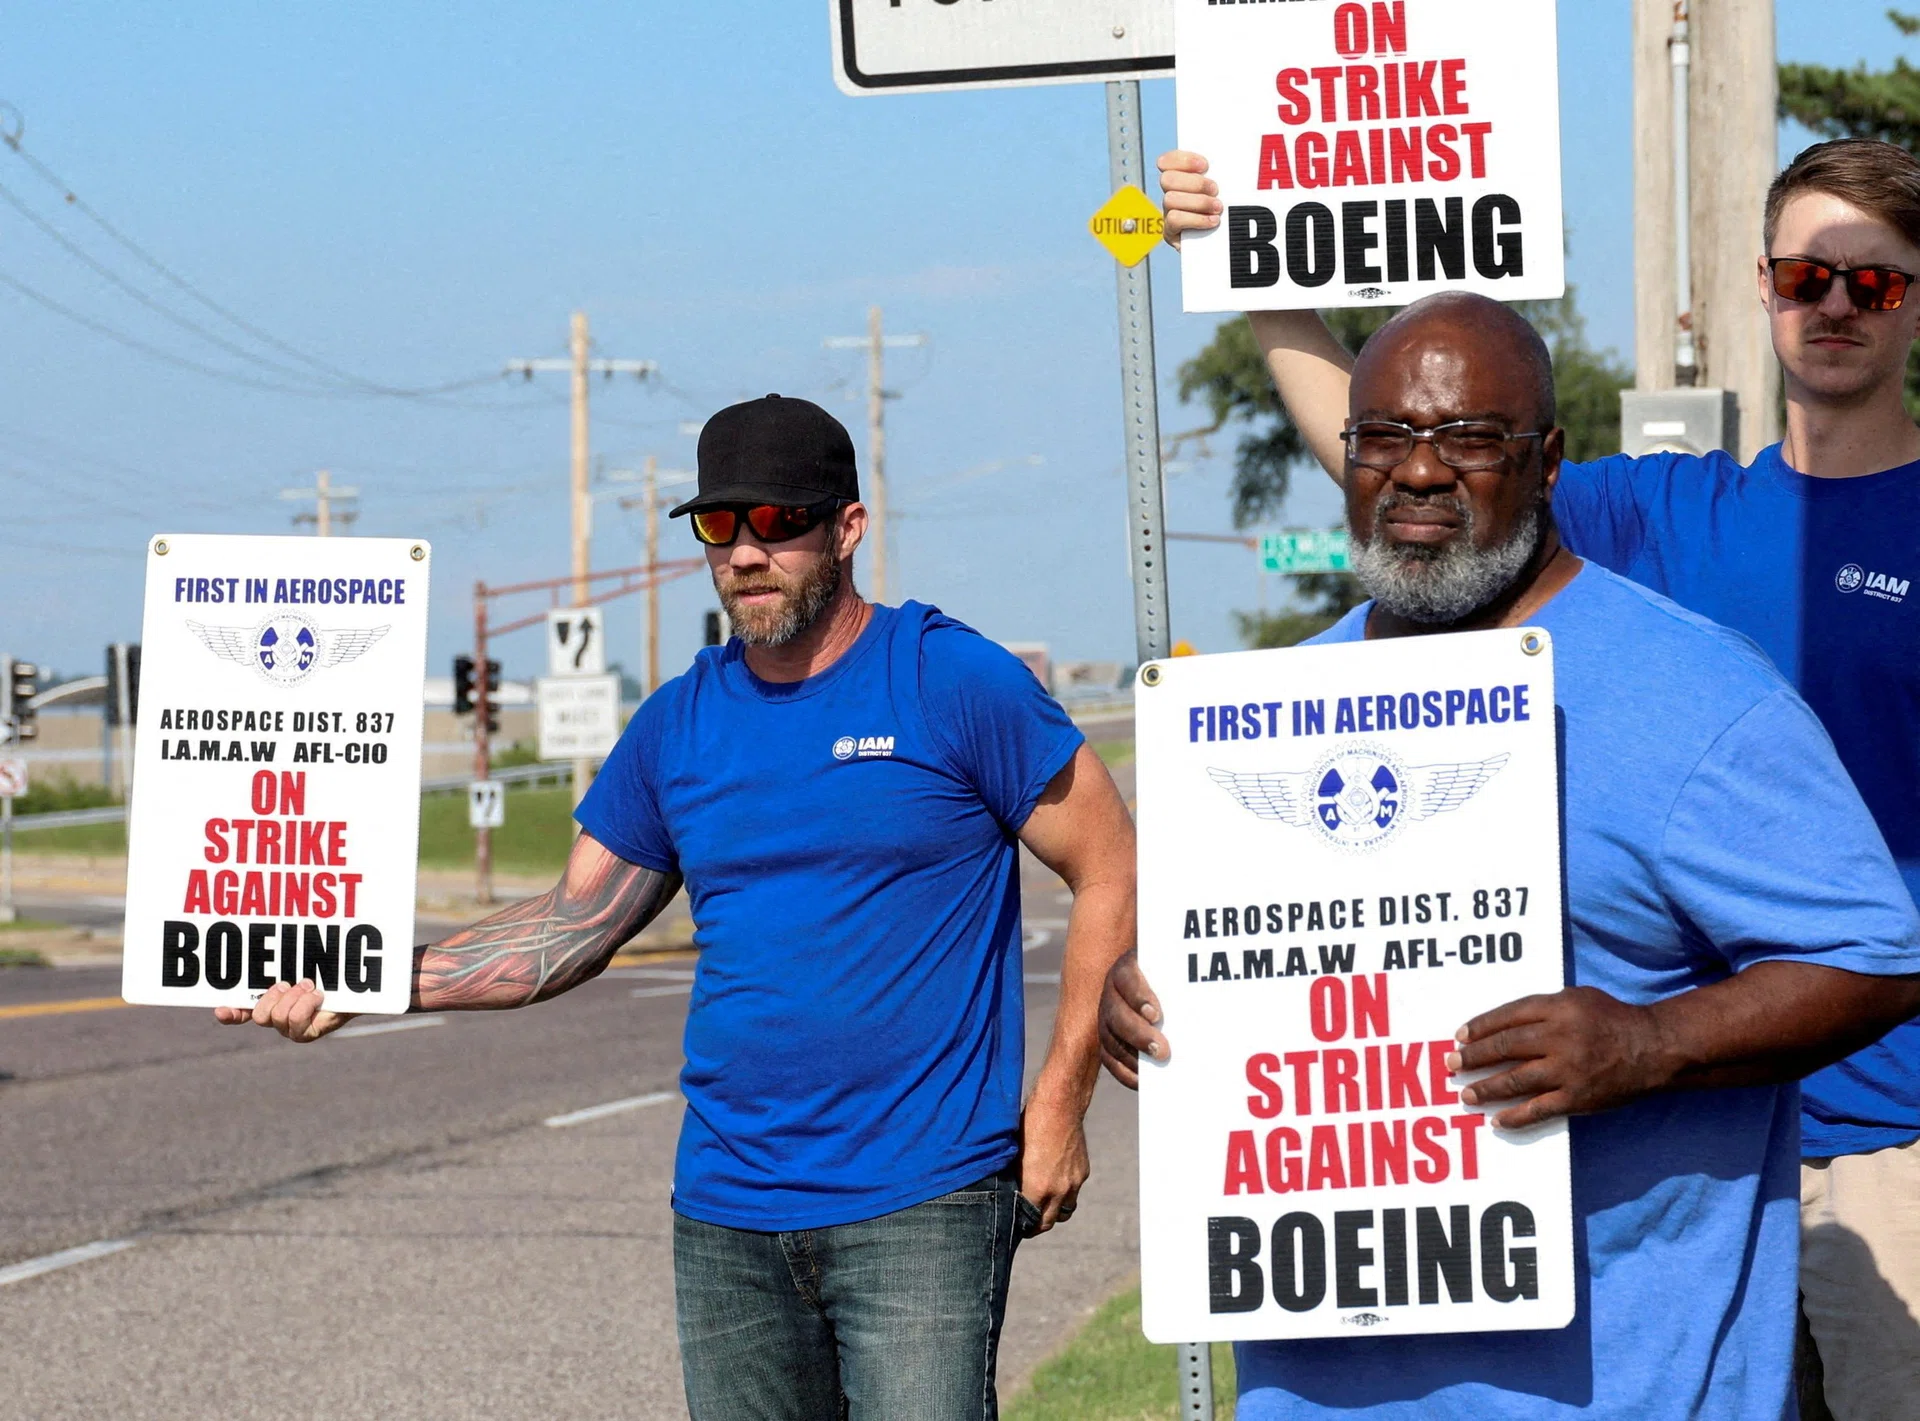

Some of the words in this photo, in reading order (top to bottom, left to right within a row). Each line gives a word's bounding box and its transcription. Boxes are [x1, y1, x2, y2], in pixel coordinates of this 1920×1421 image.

[1335, 1, 1406, 59] ON
[1276, 56, 1469, 126] STRIKE
[1257, 121, 1492, 190] AGAINST
[1093, 217, 1164, 235] UTILTIES
[1227, 193, 1524, 289] BOEING
[175, 578, 238, 602] FIRST
[246, 580, 267, 602] IN
[275, 579, 404, 604] AEROSPACE
[1863, 589, 1891, 600] DISTRICT
[1865, 571, 1910, 596] IAM
[160, 709, 284, 732] AEROSPACE
[293, 711, 346, 733] DIST.
[355, 712, 394, 734] 837
[1189, 702, 1283, 743] FIRST
[1292, 699, 1325, 737] IN
[1335, 684, 1530, 734] AEROSPACE
[161, 739, 277, 762] I.A.M.A.W
[293, 742, 388, 764] AFL-CIO
[858, 736, 895, 750] IAM
[251, 769, 306, 816] ON
[204, 817, 347, 867] STRIKE
[183, 869, 363, 919] AGAINST
[1183, 898, 1365, 939] AEROSPACE
[1379, 892, 1458, 926] DIST.
[1473, 887, 1529, 919] 837
[161, 920, 383, 994] BOEING
[1188, 943, 1356, 983] I.A.M.A.W
[1383, 932, 1523, 971] AFL-CIO
[1309, 972, 1390, 1043] ON
[1245, 1039, 1459, 1119] STRIKE
[1224, 1113, 1485, 1196] AGAINST
[1207, 1201, 1539, 1314] BOEING
